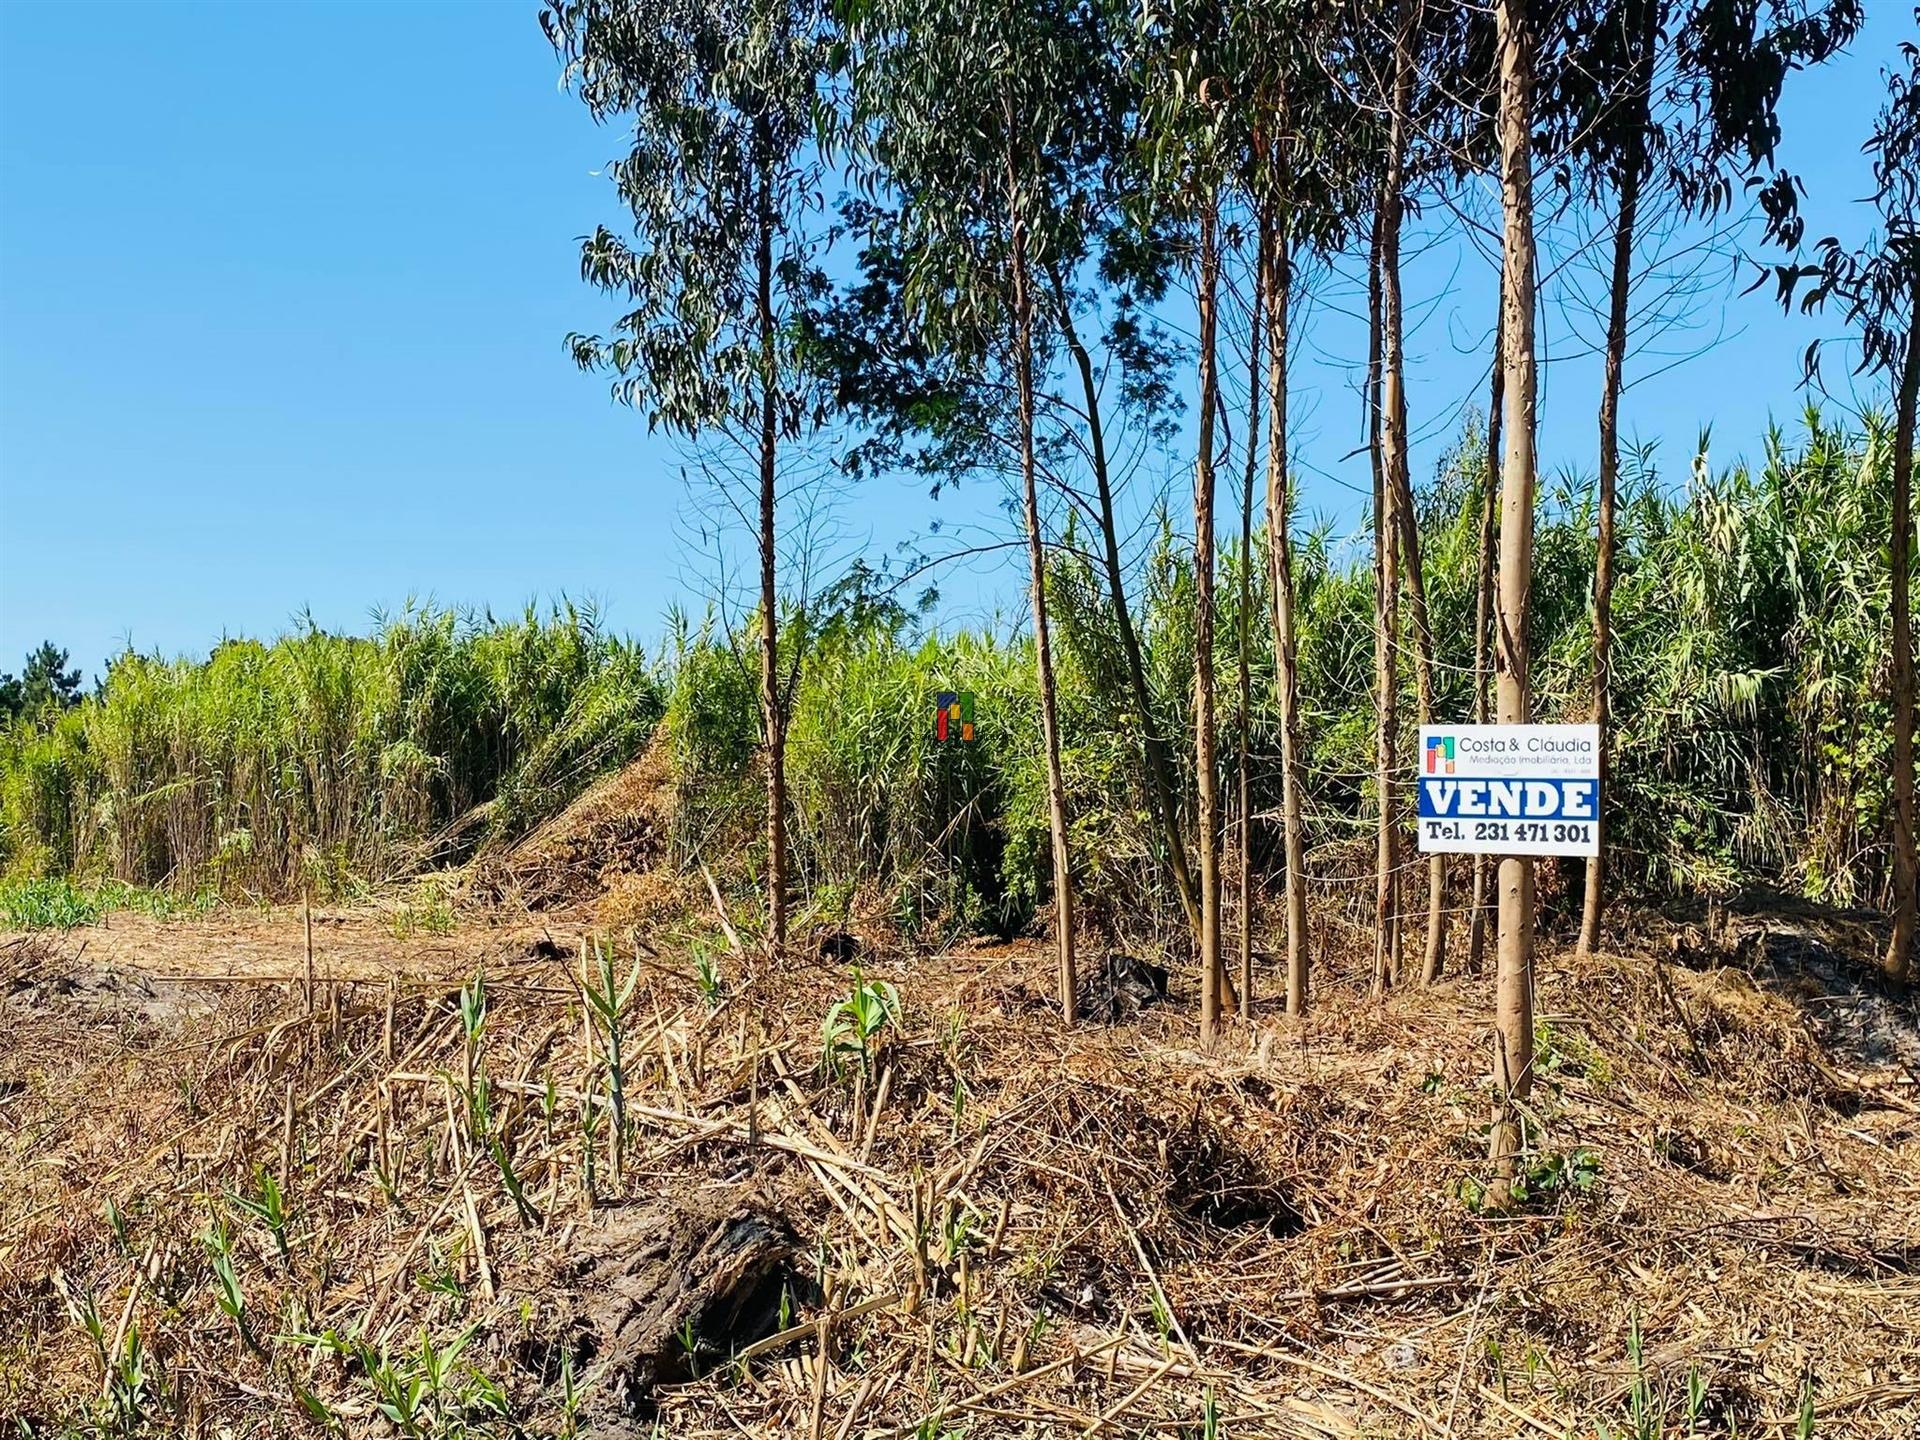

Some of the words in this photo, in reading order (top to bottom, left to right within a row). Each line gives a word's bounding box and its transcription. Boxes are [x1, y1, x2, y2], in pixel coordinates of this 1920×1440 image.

[1460, 737, 1506, 753] Costa
[1509, 737, 1520, 753] &
[1527, 736, 1591, 753] Cláudia
[1469, 755, 1517, 766] Mediação
[1574, 755, 1592, 765] Lda
[1425, 780, 1592, 817] VENDE
[1426, 822, 1466, 841] Tel.
[1474, 822, 1510, 841] 231
[1514, 823, 1549, 842] 471
[1553, 824, 1591, 843] 301
